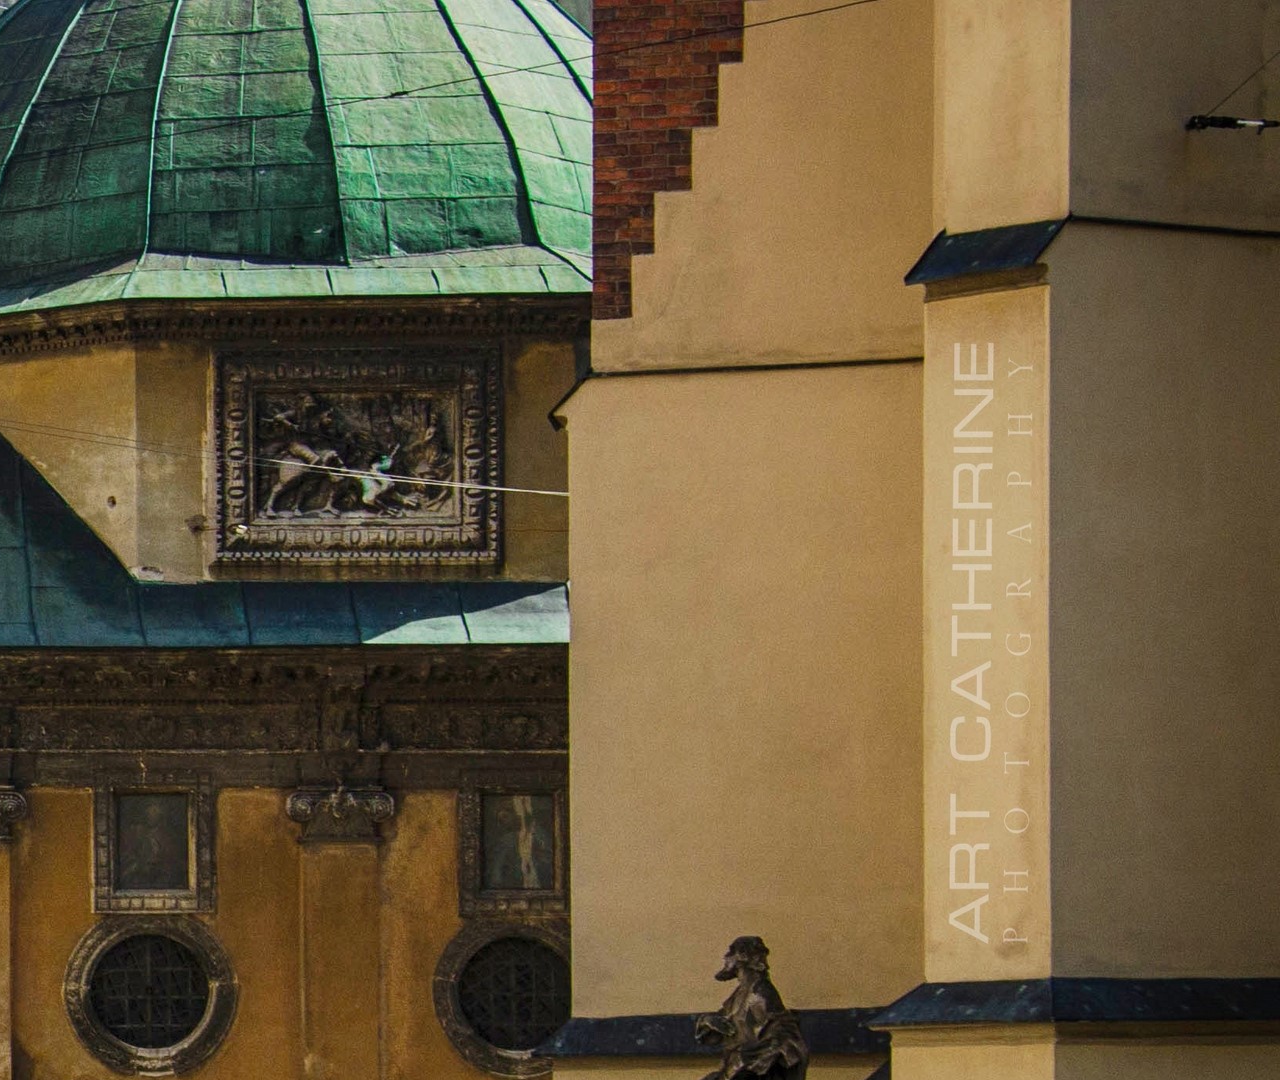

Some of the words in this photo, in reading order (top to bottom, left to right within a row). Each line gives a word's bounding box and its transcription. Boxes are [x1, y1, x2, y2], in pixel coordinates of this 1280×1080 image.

[949, 342, 995, 763] CATHERINE
[1002, 358, 1035, 945] PHOTOGRAPHY
[948, 793, 991, 945] ART
